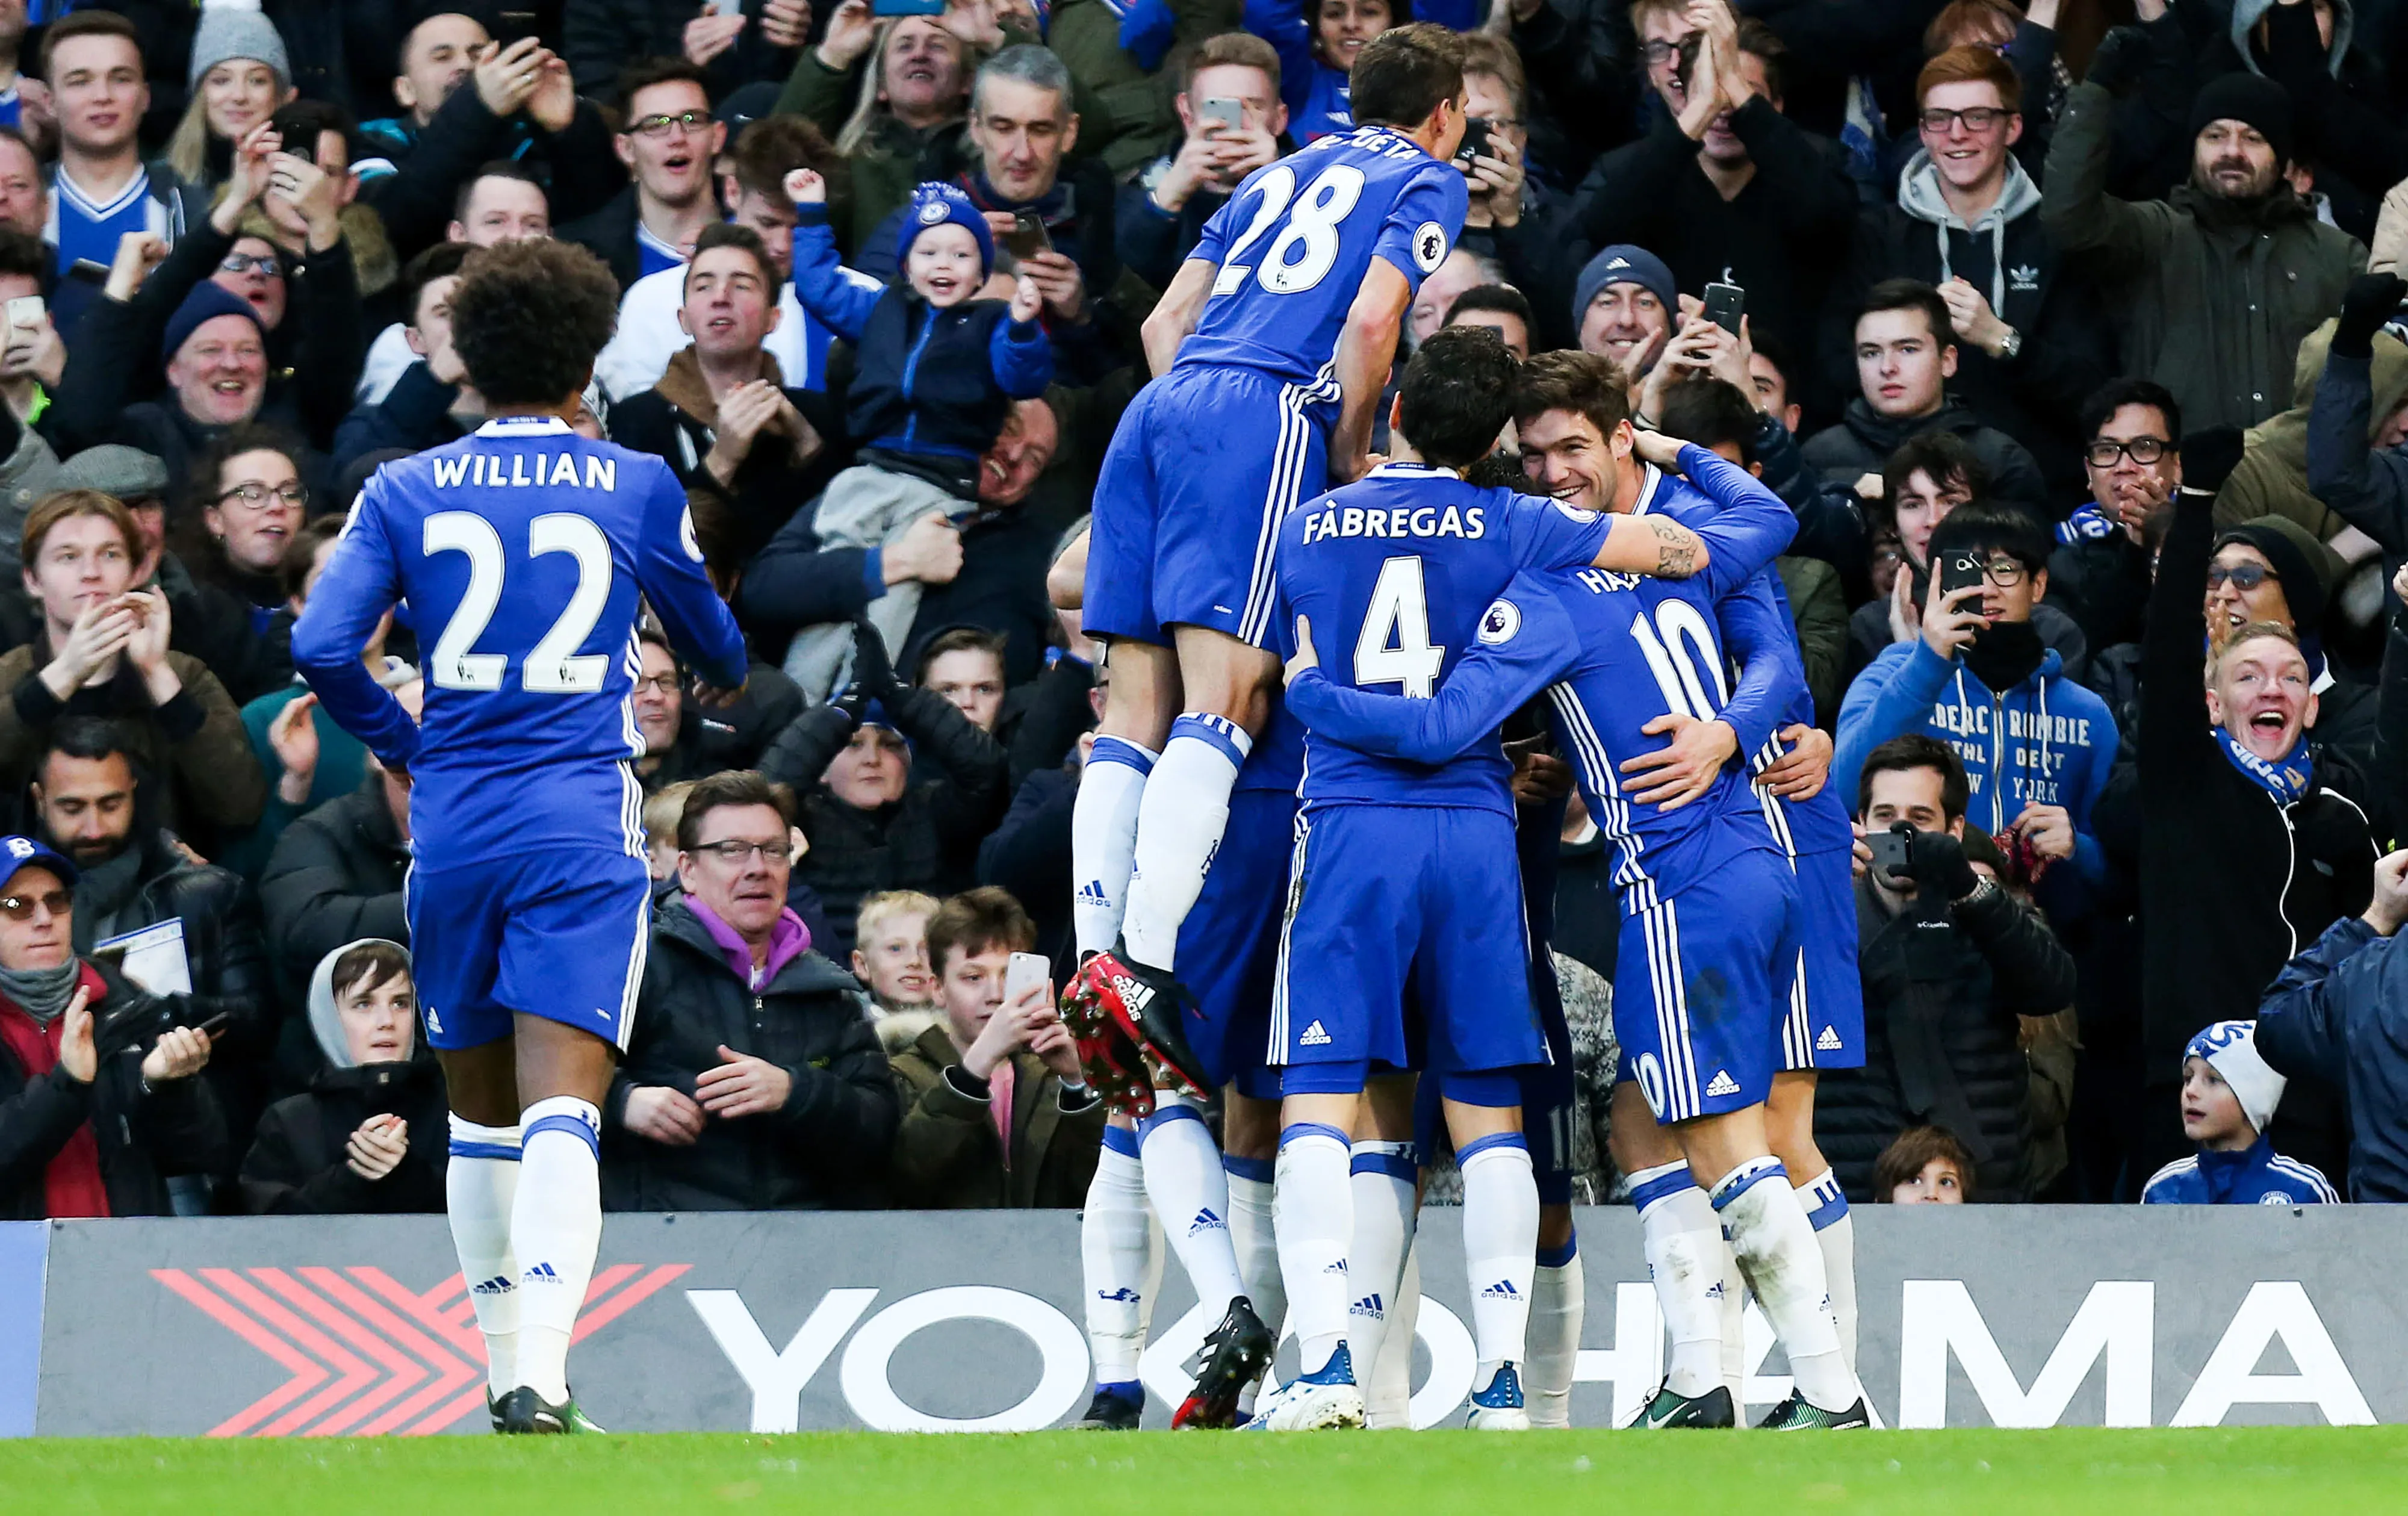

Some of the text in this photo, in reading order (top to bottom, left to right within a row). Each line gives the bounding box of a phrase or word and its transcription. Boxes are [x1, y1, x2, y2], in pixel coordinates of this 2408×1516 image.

[1211, 164, 1365, 295] 28
[433, 453, 617, 492] WILLIAN
[423, 510, 613, 693] 22
[1353, 555, 1445, 700] 4
[1630, 598, 1729, 722] 10
[1943, 740, 1987, 764] THL
[6, 837, 36, 859] B
[1113, 974, 1141, 1022] adidas
[1299, 1035, 1332, 1046] adidas
[1816, 1041, 1843, 1050] adidas
[1631, 1052, 1666, 1119] 10
[1705, 1084, 1741, 1097] adidas
[1481, 1291, 1524, 1301] adidas
[1350, 1306, 1384, 1321] adidas
